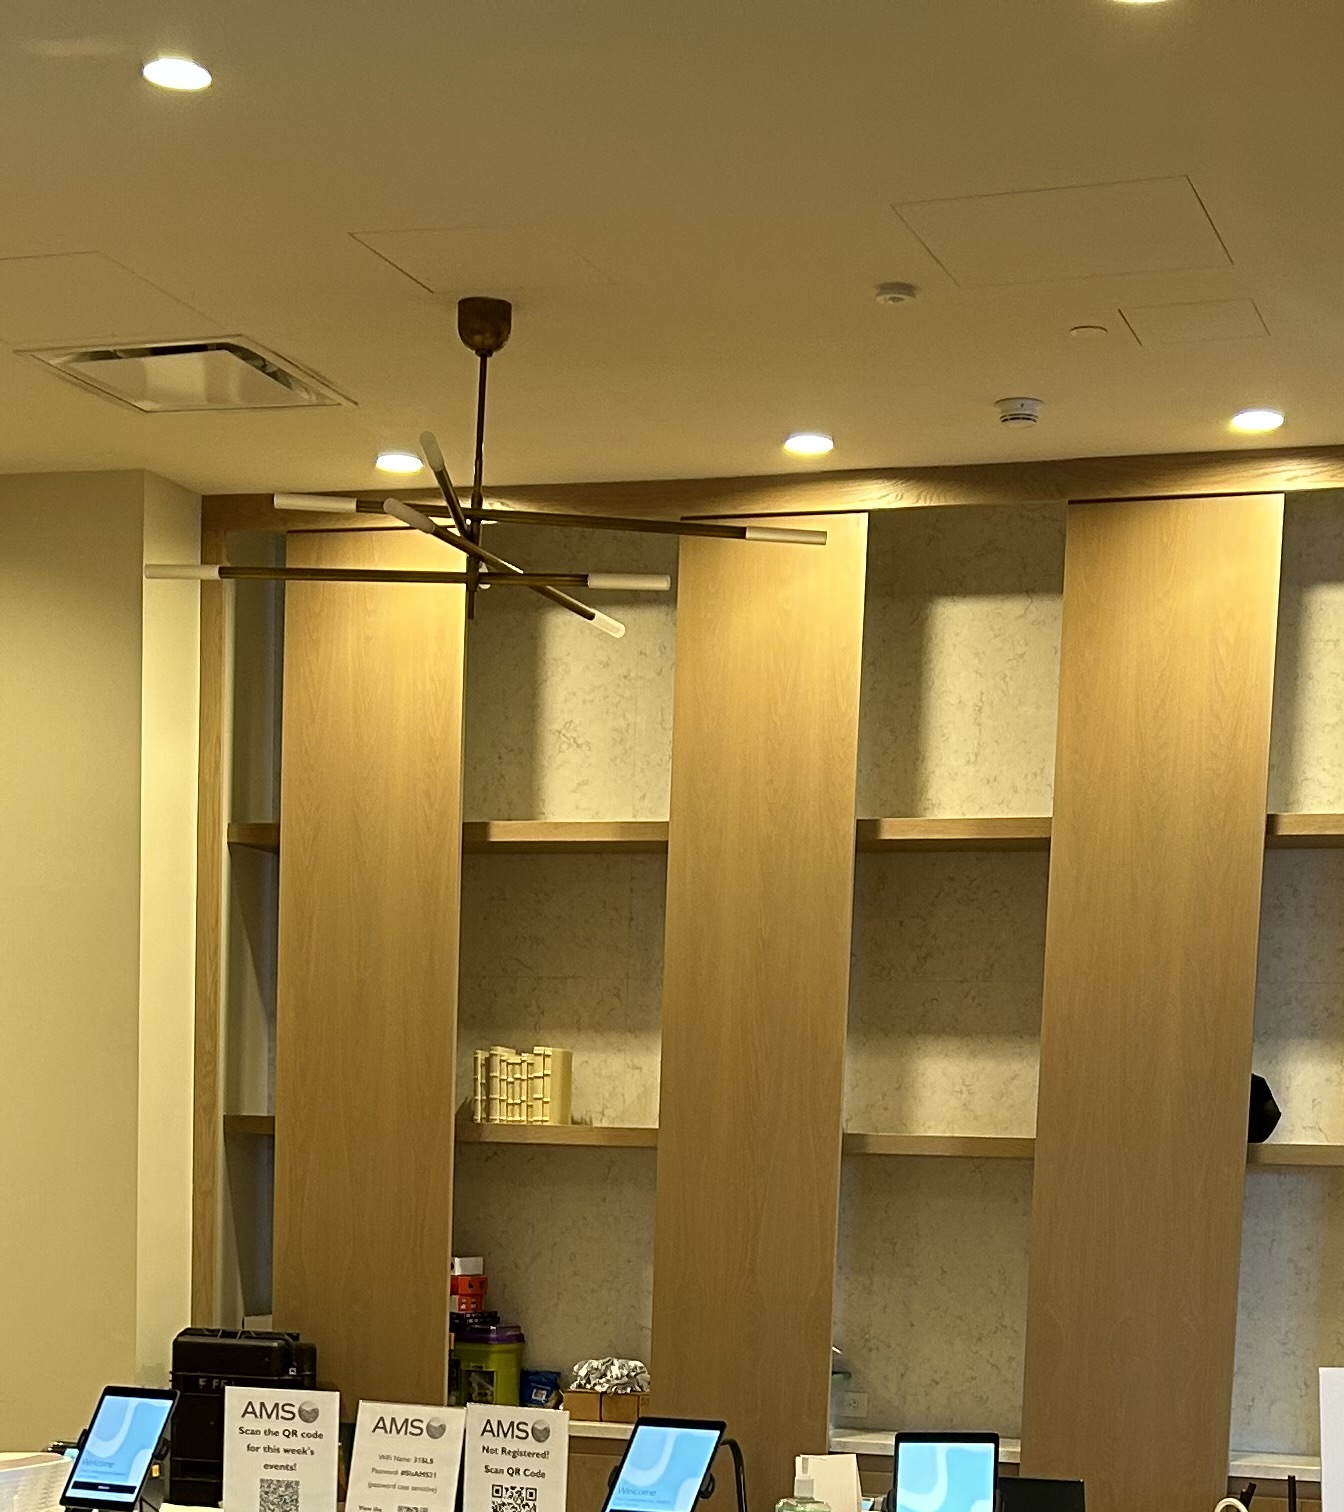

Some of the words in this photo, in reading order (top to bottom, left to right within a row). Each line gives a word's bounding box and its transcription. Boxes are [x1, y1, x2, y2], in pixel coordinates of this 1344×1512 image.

[241, 1401, 296, 1420] AMS
[239, 1426, 261, 1435] Scan
[264, 1428, 279, 1436] the
[282, 1429, 298, 1438] QR
[301, 1431, 323, 1439] code
[372, 1416, 424, 1436] AMS
[481, 1419, 529, 1440] AMS
[246, 1443, 261, 1452] for
[263, 1445, 280, 1453] this
[283, 1446, 314, 1455] week's
[482, 1445, 499, 1455] Not
[263, 1463, 297, 1471] events!
[484, 1465, 504, 1474] Scan
[507, 1467, 521, 1477] QR
[523, 1469, 545, 1478] Code
